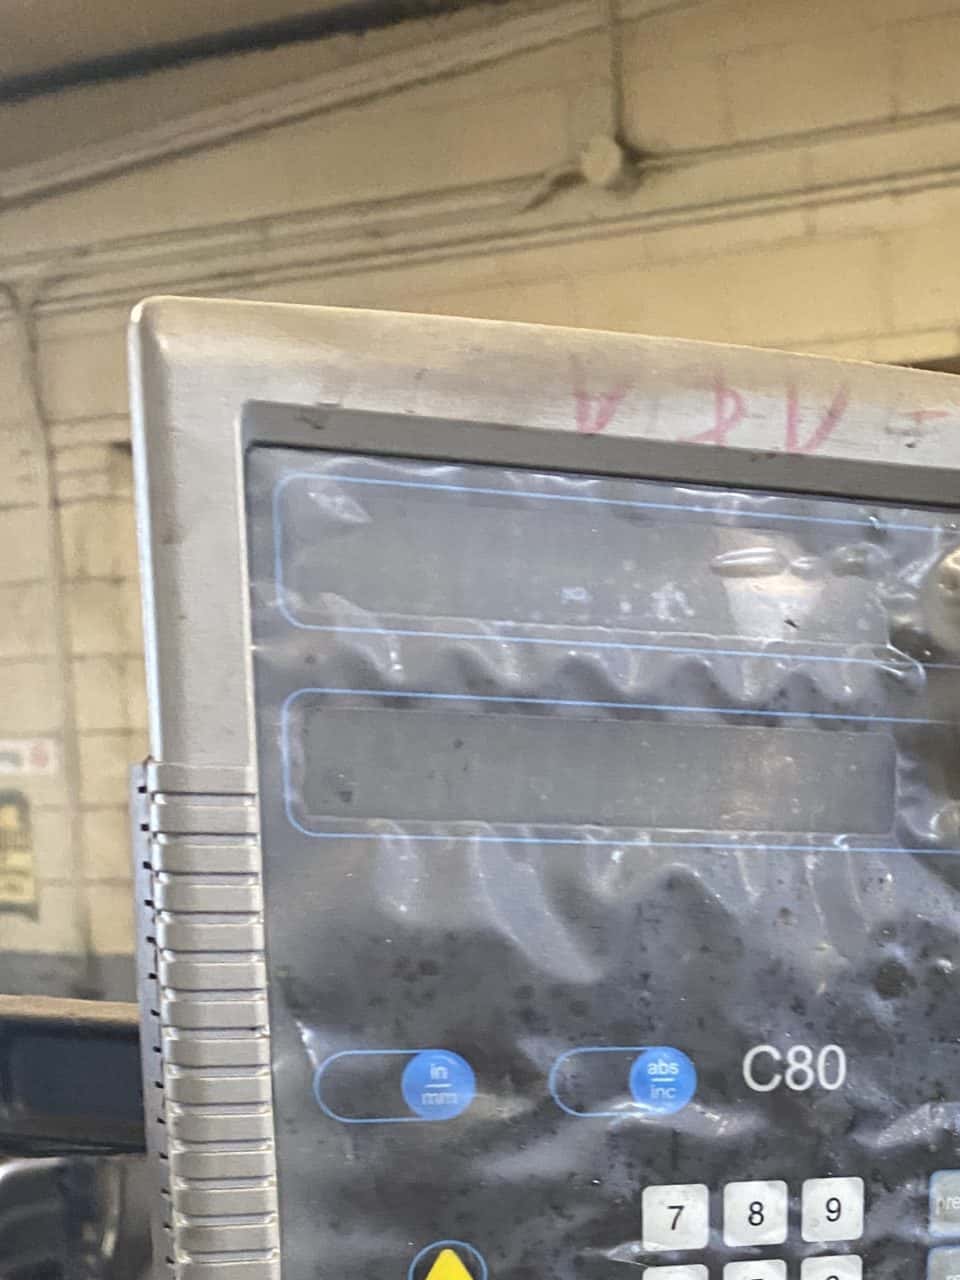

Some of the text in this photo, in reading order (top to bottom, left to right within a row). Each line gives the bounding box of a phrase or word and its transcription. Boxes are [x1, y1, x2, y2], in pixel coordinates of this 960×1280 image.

[429, 1062, 448, 1080] in
[646, 1058, 679, 1077] abs
[743, 1043, 848, 1093] C80
[421, 1090, 458, 1106] mm
[650, 1083, 677, 1099] inc
[668, 1205, 684, 1231] 7
[747, 1201, 765, 1226] 8
[825, 1197, 842, 1222] 9
